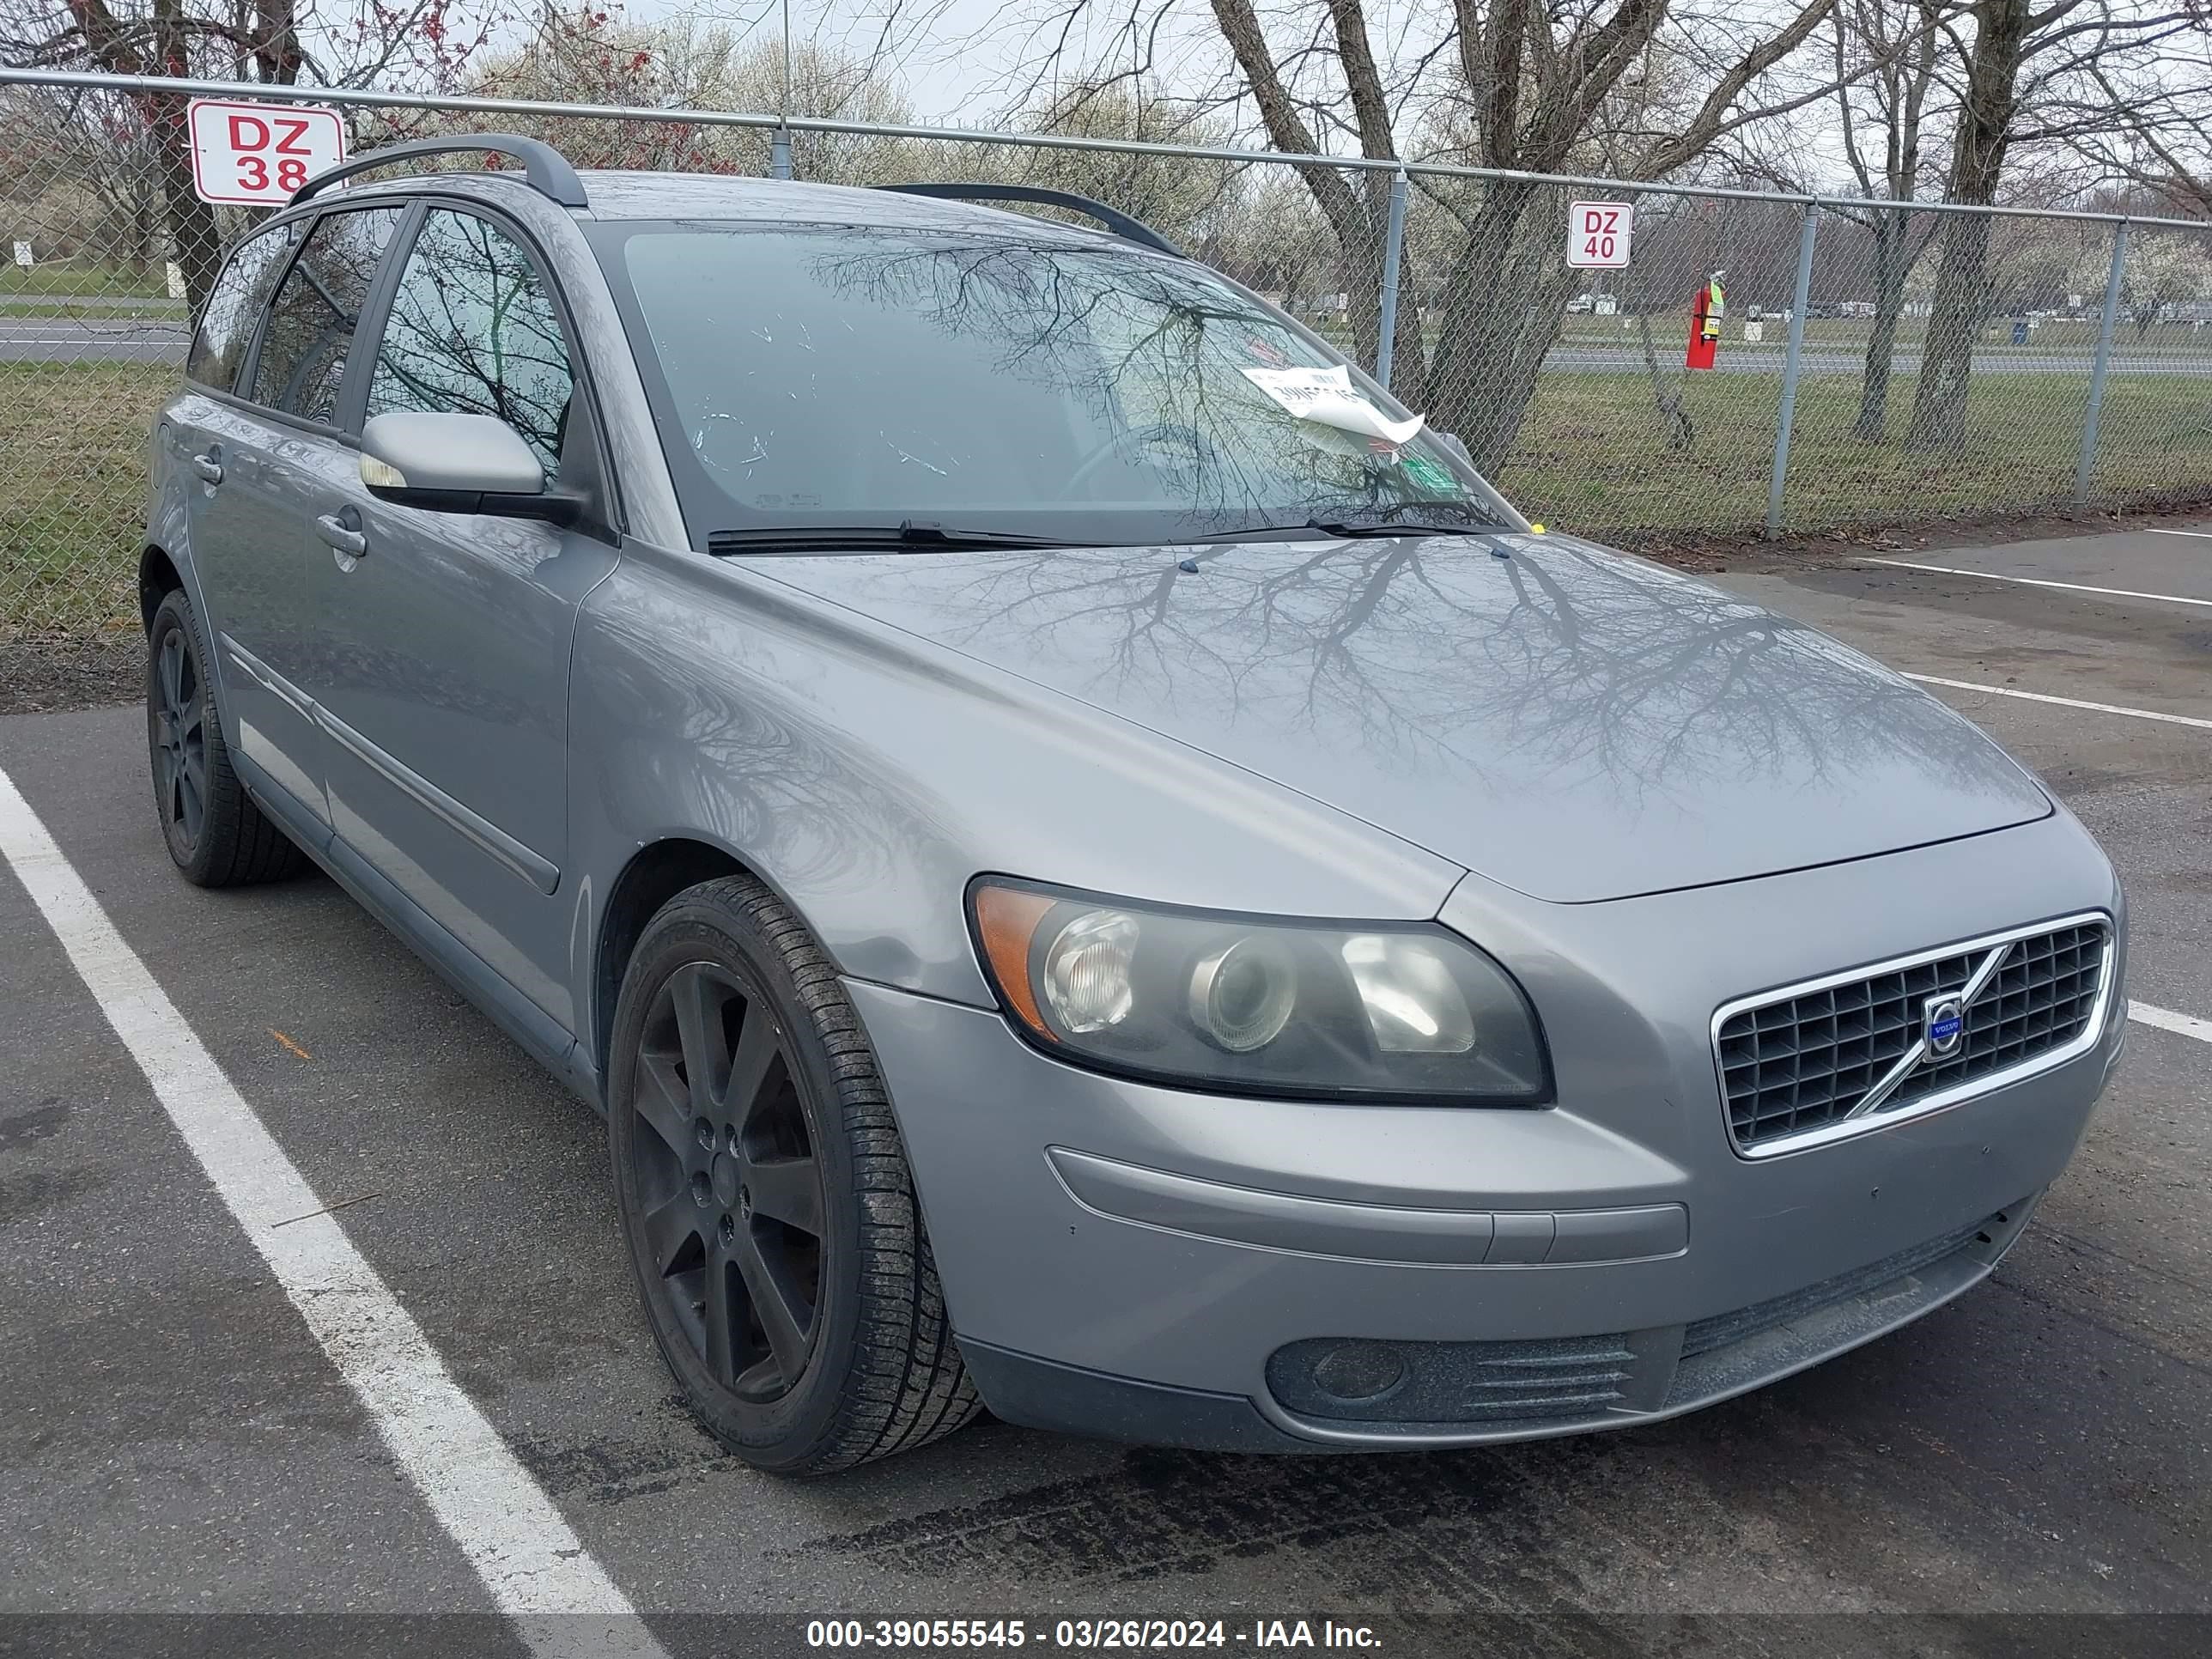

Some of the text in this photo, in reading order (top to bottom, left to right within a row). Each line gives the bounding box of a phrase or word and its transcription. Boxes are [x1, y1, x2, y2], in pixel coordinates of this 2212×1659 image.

[228, 115, 312, 156] DZ
[236, 156, 308, 193] 38
[1584, 210, 1620, 234] DZ
[1583, 236, 1614, 258] 40
[1935, 1022, 1958, 1033] VOLVO
